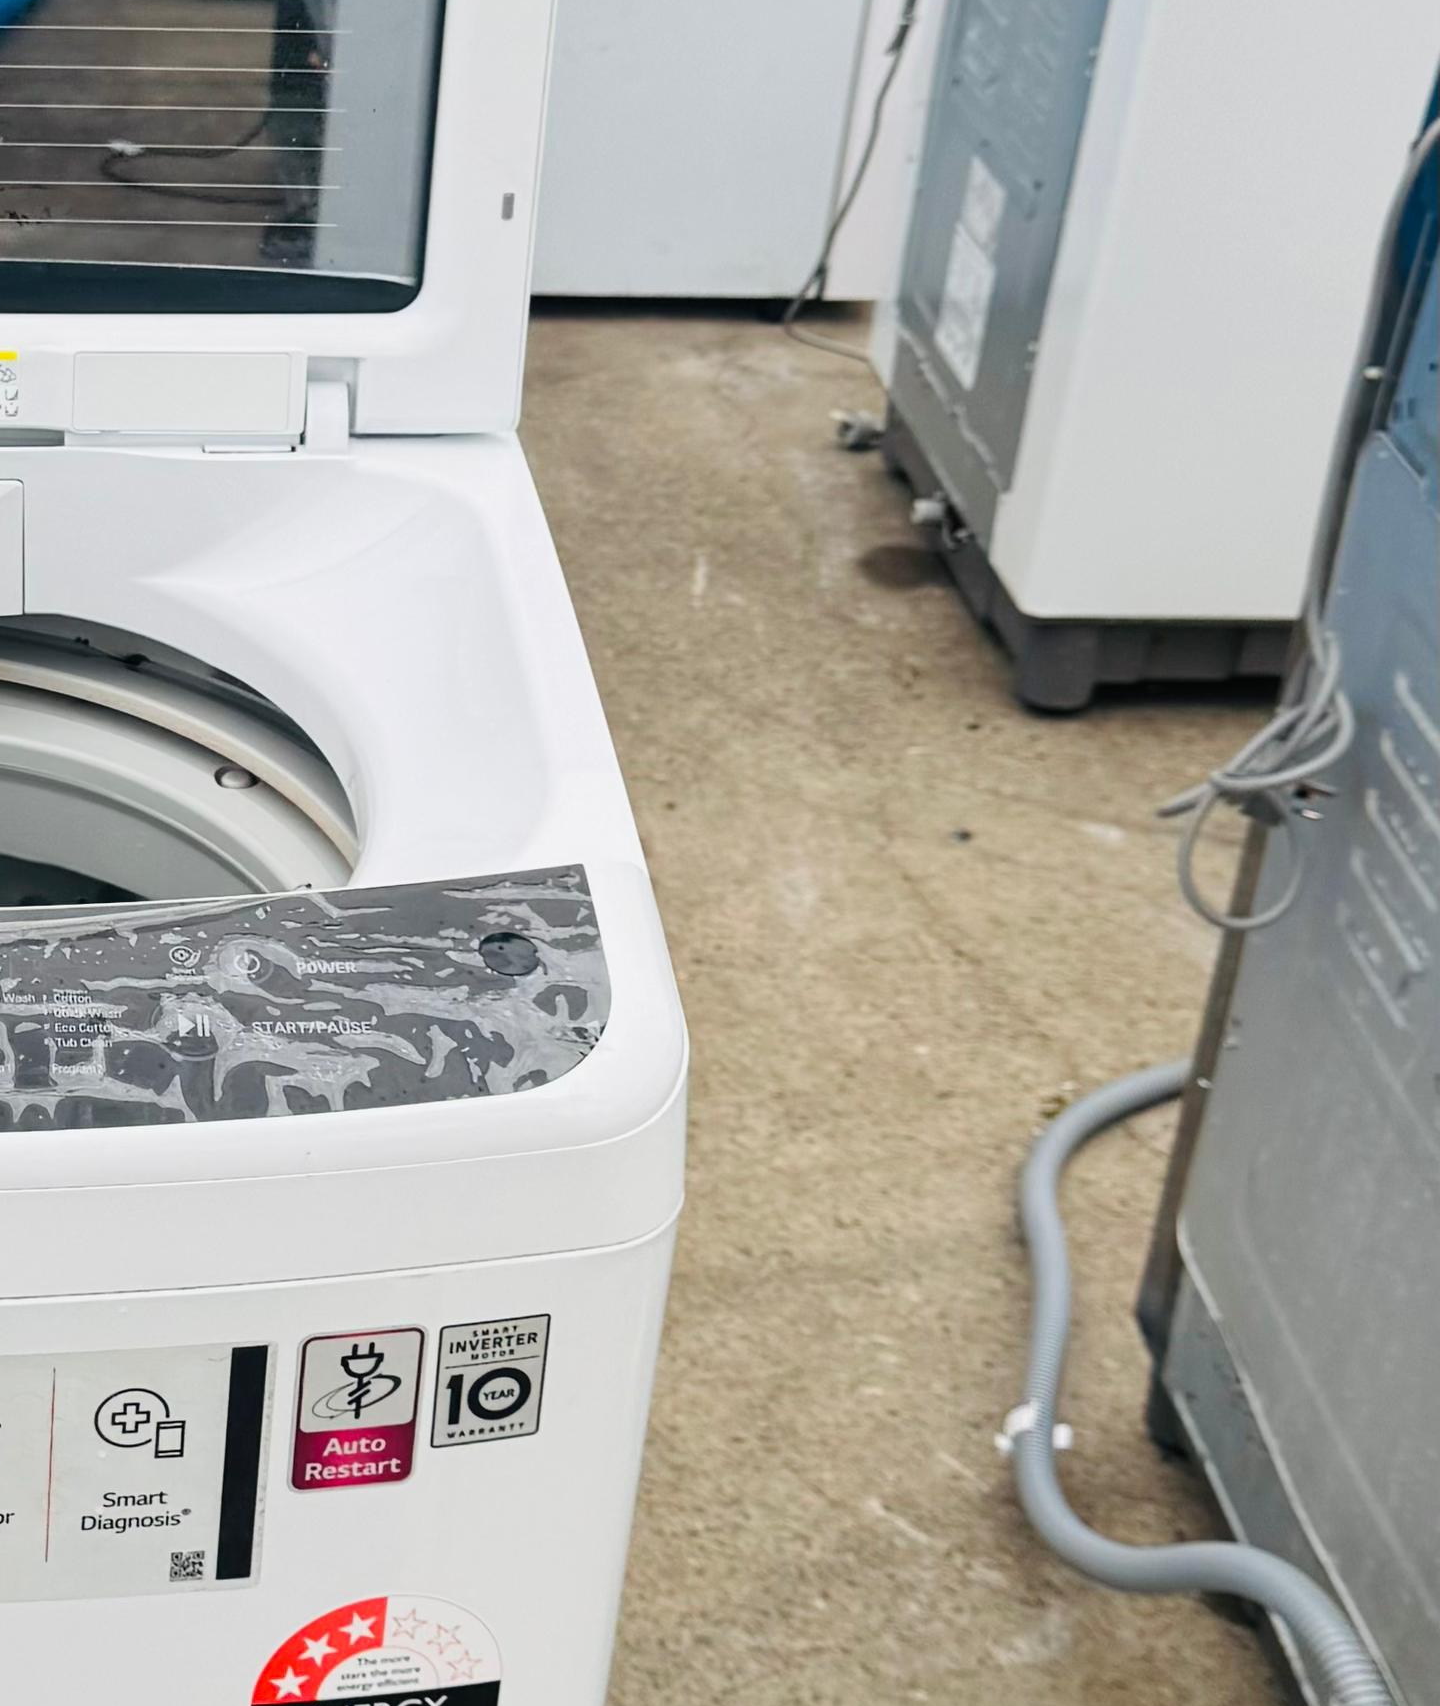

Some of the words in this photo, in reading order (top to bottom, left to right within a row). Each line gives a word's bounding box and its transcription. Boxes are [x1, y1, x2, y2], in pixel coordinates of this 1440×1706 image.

[296, 961, 358, 974] POWER
[2, 993, 36, 1003] Wash
[54, 1023, 75, 1033] Eco
[79, 1023, 116, 1033] Cotto
[252, 1021, 371, 1034] START/PAUSE
[55, 1038, 77, 1048] Tub
[473, 1325, 518, 1338] SMART
[449, 1332, 538, 1354] INVERTER
[471, 1349, 515, 1361] MOTOR
[446, 1367, 531, 1425] 10
[483, 1388, 515, 1401] YEAR
[447, 1422, 525, 1439] WARRANTY
[322, 1435, 387, 1458] Auto
[304, 1454, 402, 1482] Restart
[102, 1491, 168, 1508] Smart
[358, 1658, 377, 1666] The
[380, 1656, 410, 1664] more
[370, 1669, 388, 1677] the
[391, 1666, 421, 1675] more
[337, 1682, 373, 1692] energy
